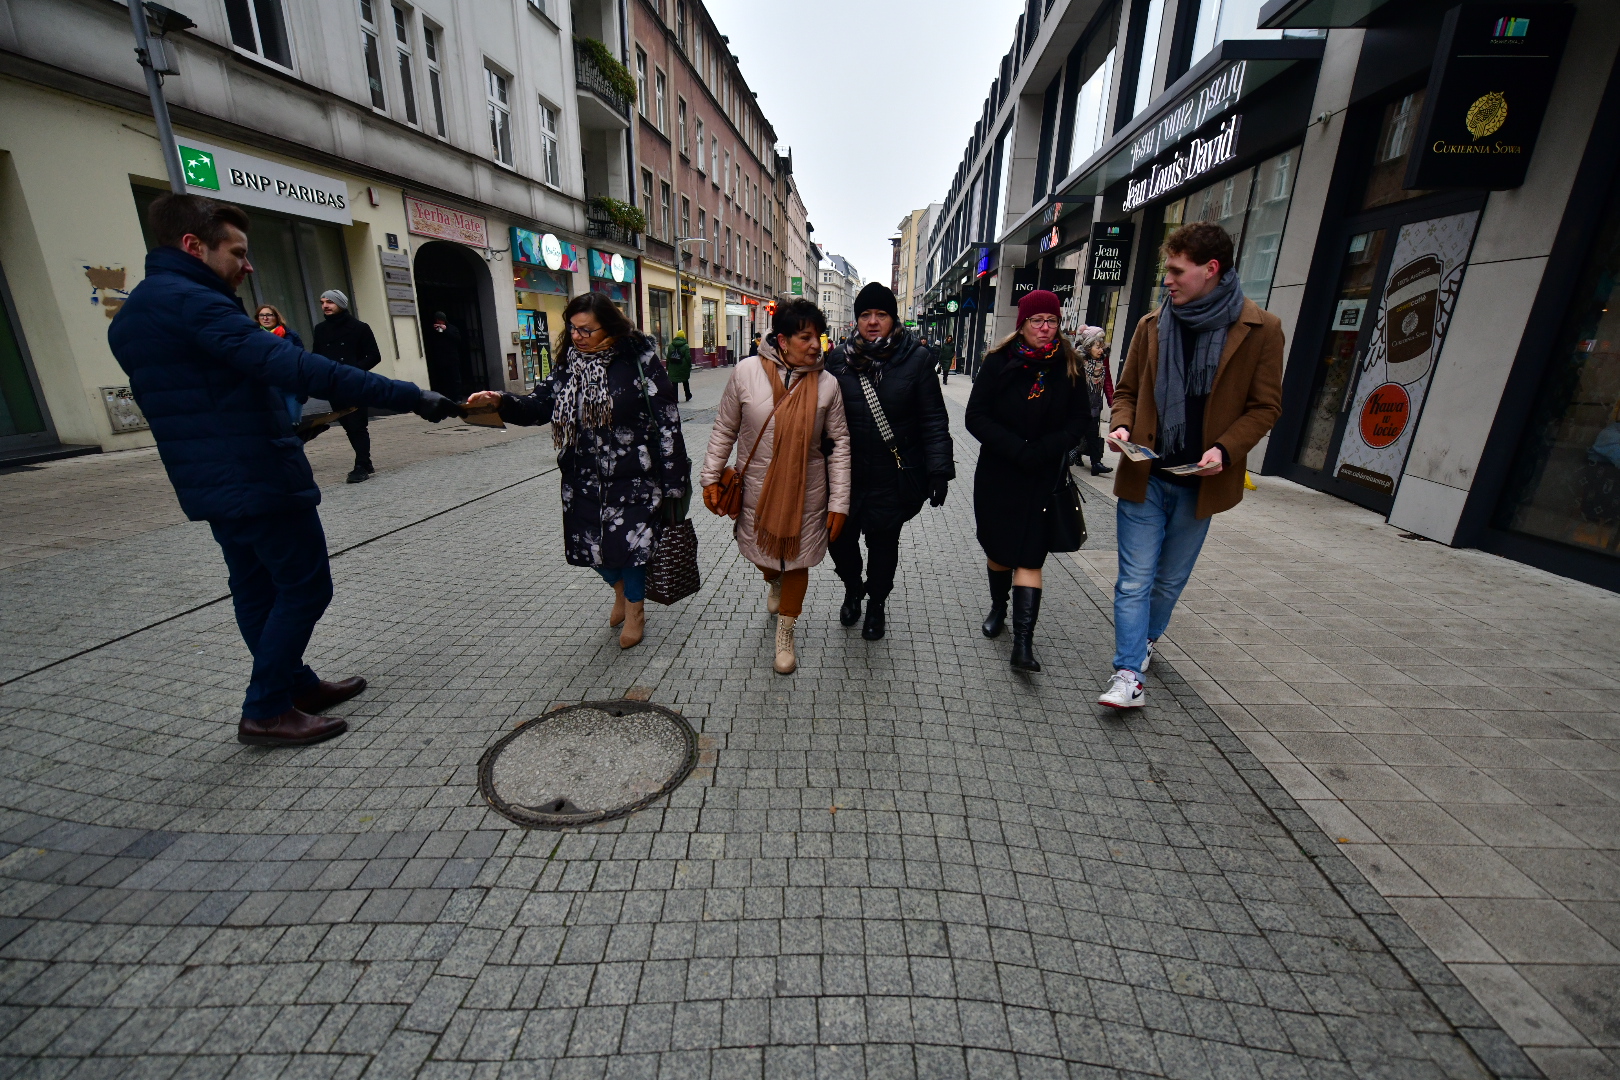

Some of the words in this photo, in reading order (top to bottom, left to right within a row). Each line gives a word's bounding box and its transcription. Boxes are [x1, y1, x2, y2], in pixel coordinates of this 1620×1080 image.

[1433, 140, 1489, 154] CUKIERNIA
[1493, 140, 1521, 154] SOWA
[1122, 179, 1147, 212] Jean
[1147, 151, 1184, 199] Louis
[1185, 114, 1238, 179] David
[229, 168, 271, 192] BNP
[274, 179, 345, 210] PARIBAS
[414, 202, 451, 226] Yerba
[453, 213, 481, 232] Mate
[1095, 244, 1119, 257] Jean
[1094, 257, 1122, 269] Louis
[1093, 268, 1121, 281] David
[1015, 283, 1034, 291] ING
[1369, 393, 1405, 415] Kawa
[1382, 415, 1392, 424] w
[1373, 423, 1398, 437] locie
